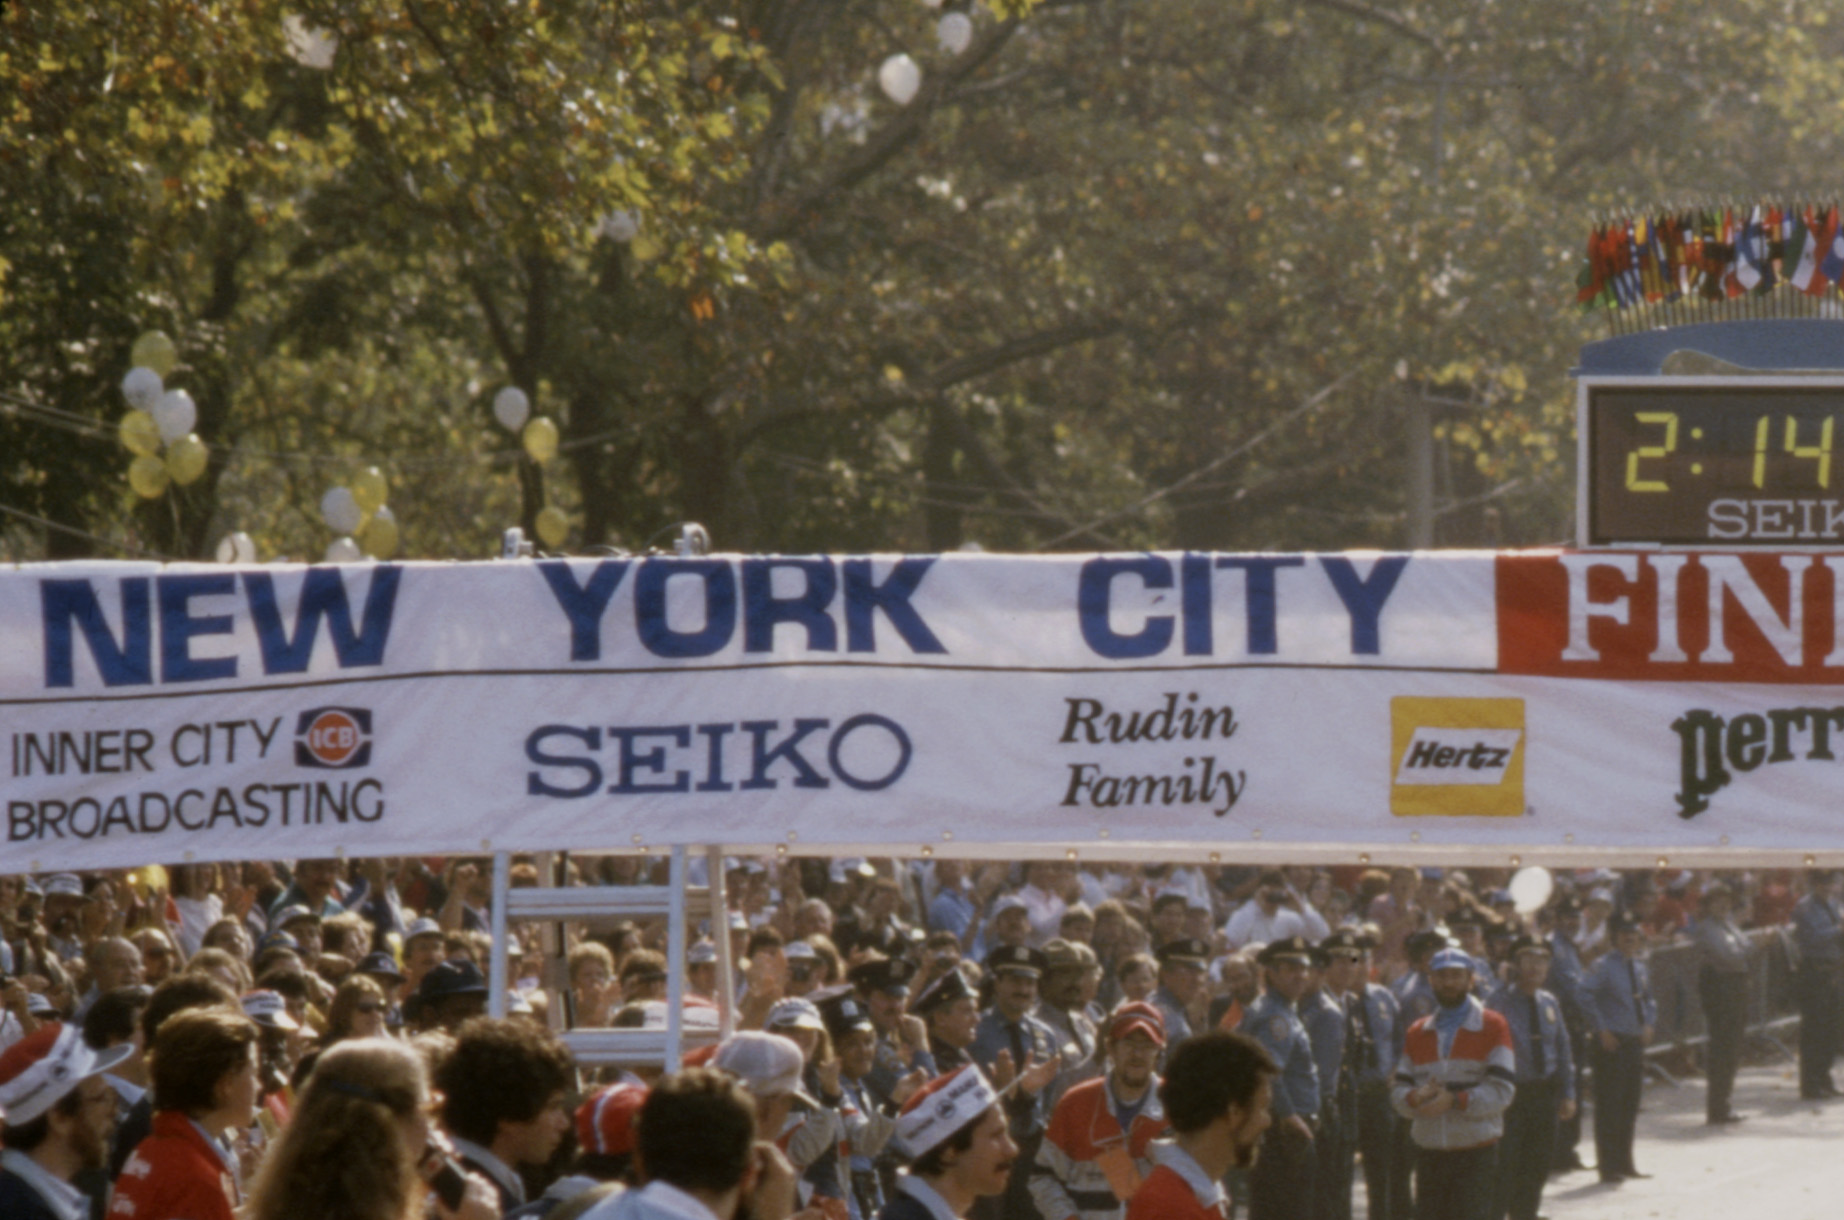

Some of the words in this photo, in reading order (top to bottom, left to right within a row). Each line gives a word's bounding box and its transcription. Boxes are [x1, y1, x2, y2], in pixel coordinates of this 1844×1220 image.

[38, 564, 403, 689] NEW
[538, 554, 949, 662] YORK
[1077, 552, 1413, 660] CITY
[11, 727, 155, 777] INNER
[169, 716, 281, 768] CITY
[312, 726, 354, 749] ICB
[1058, 692, 1239, 745] Rudin
[524, 713, 913, 799] SEIKO
[1405, 739, 1511, 770] Hertz
[7, 780, 386, 842] BROADCASTING
[1058, 756, 1247, 817] Family
